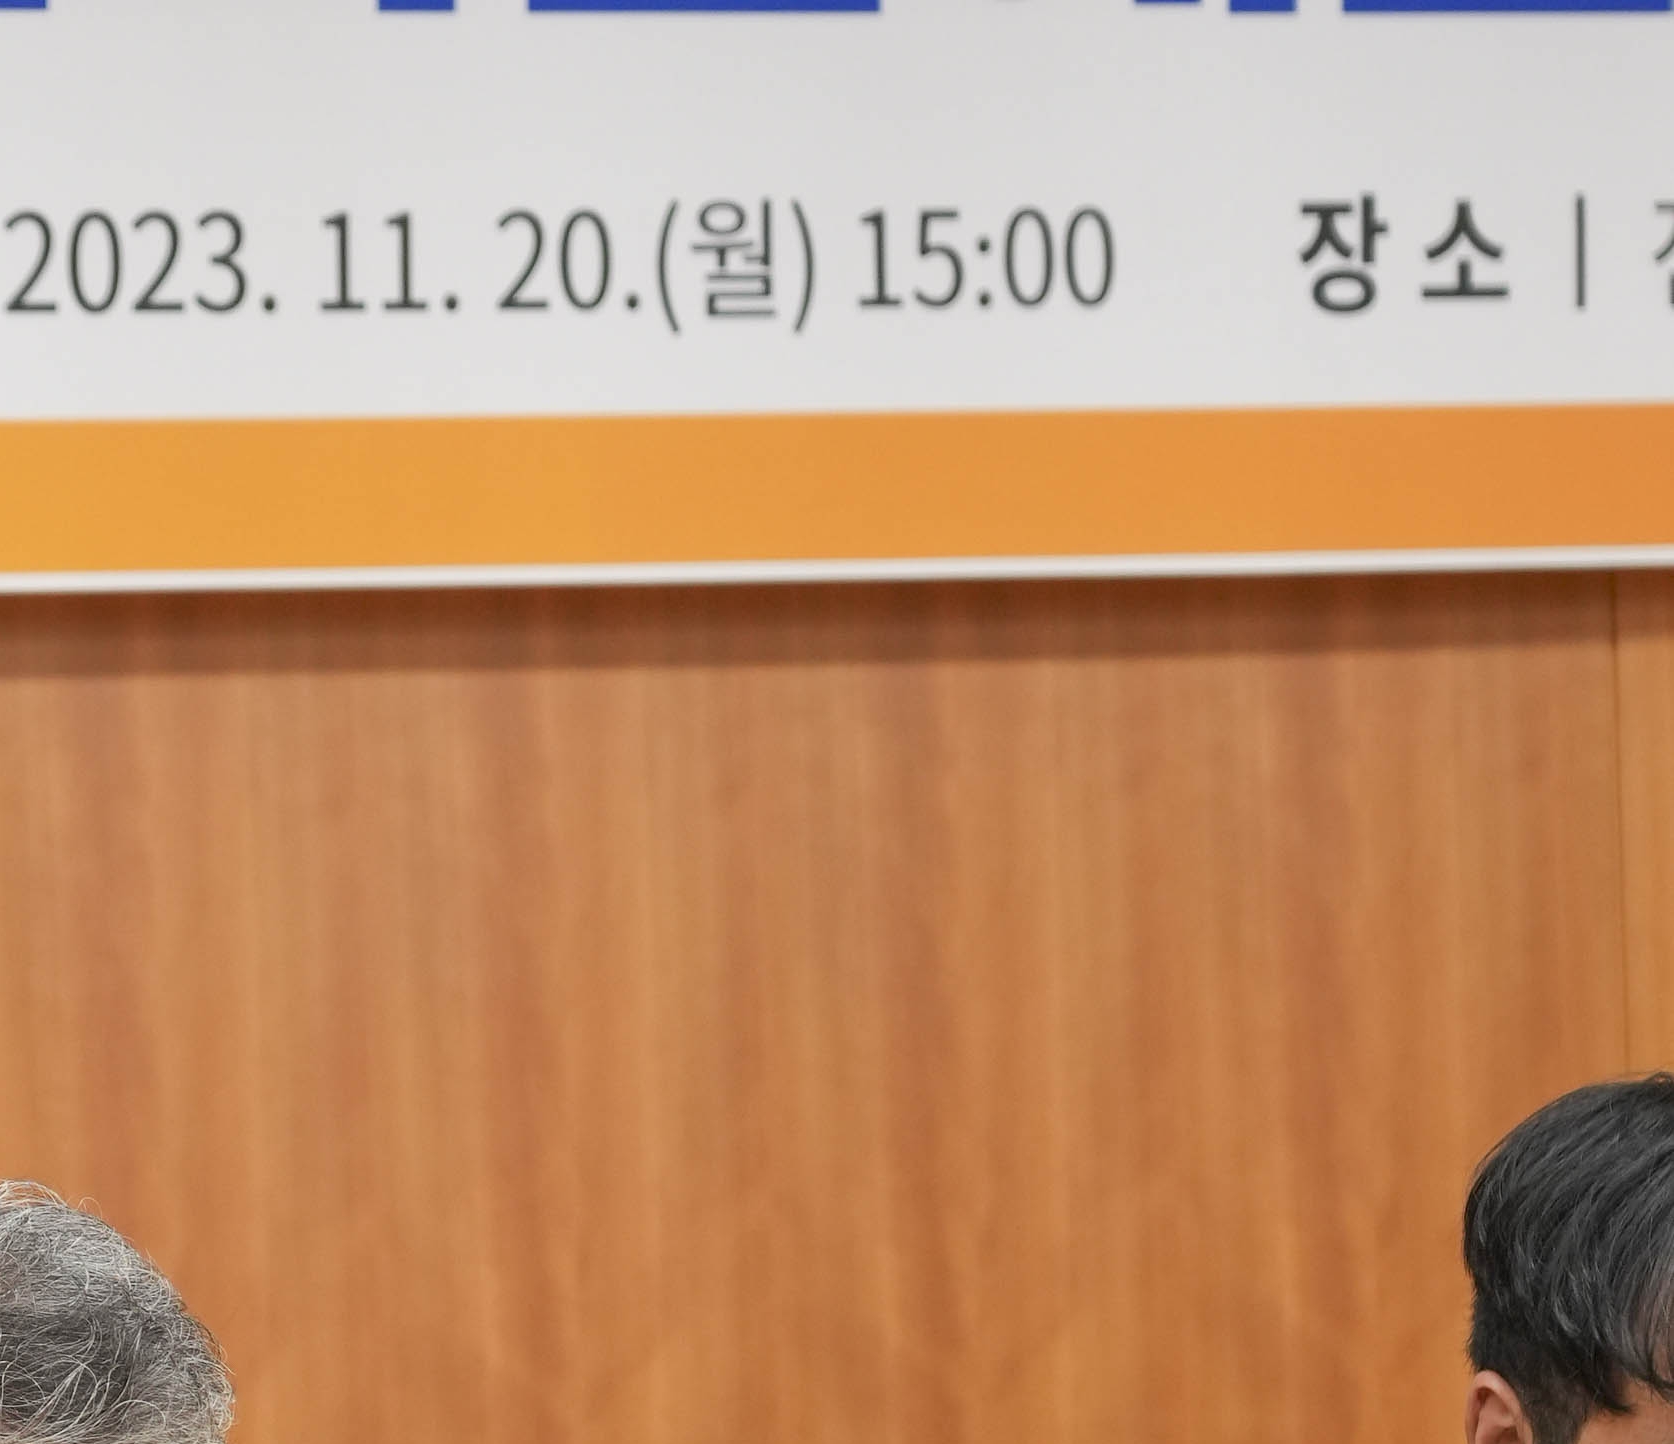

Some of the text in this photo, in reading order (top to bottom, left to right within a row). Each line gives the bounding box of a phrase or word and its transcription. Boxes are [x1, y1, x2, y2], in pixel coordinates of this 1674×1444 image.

[4, 210, 277, 314] 2023.
[320, 211, 459, 313] 11.
[497, 198, 815, 334] 20.(월)
[858, 207, 1115, 309] 15:00
